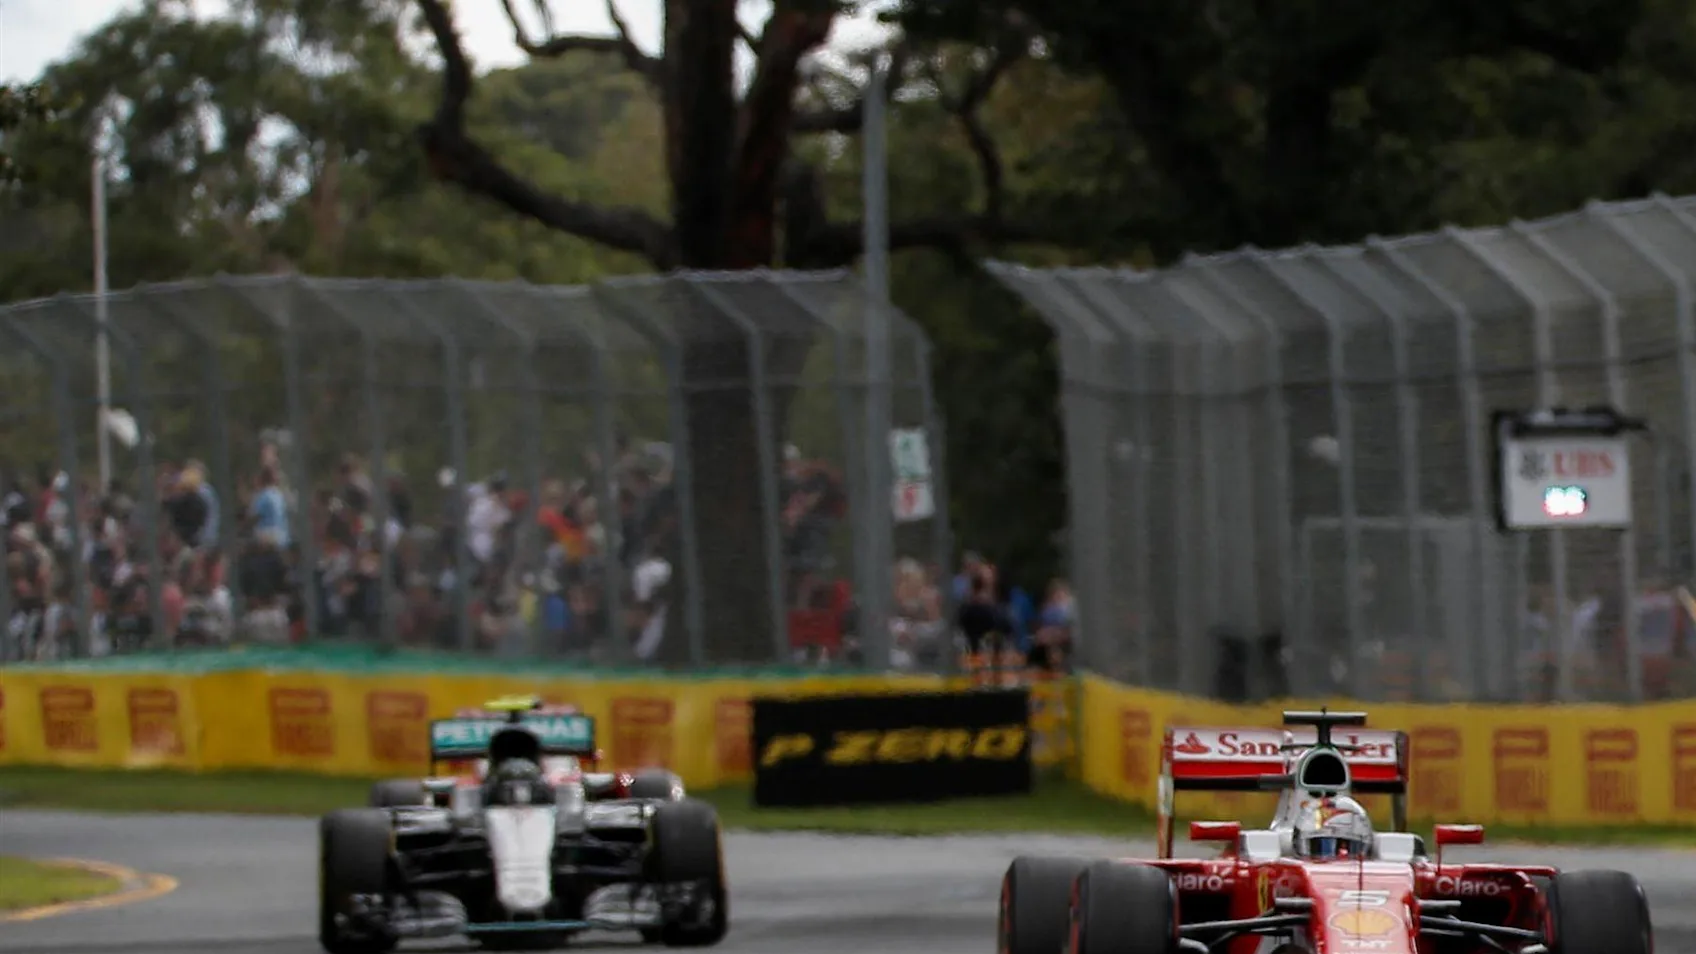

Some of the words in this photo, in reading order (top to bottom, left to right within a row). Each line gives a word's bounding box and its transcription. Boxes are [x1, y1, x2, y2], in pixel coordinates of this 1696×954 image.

[824, 724, 1027, 765] ZERO
[1217, 732, 1394, 758] Sander
[1177, 870, 1223, 891] laro
[1436, 875, 1500, 897] Claro
[1335, 889, 1391, 906] 5
